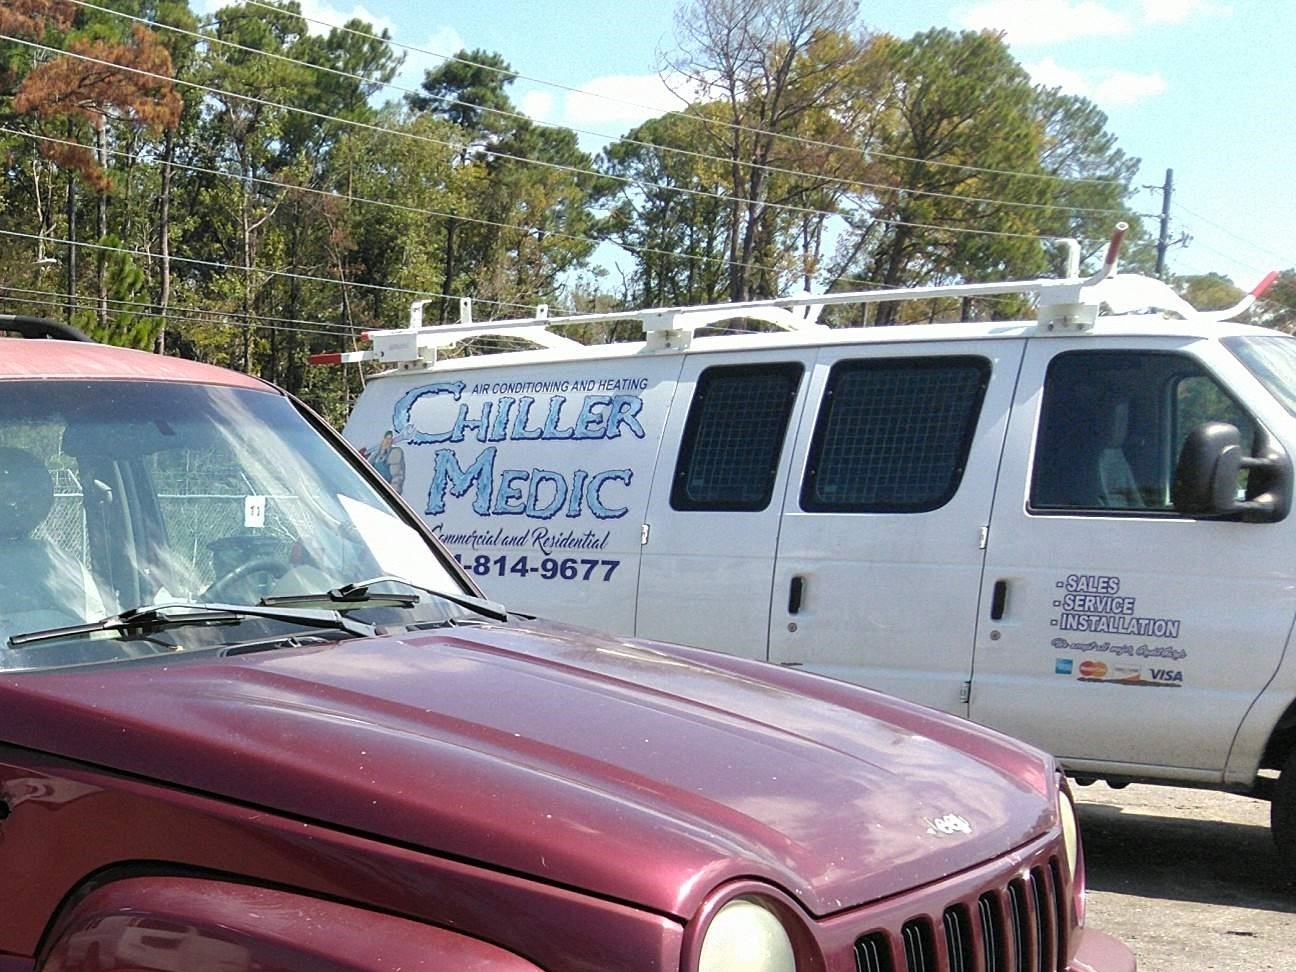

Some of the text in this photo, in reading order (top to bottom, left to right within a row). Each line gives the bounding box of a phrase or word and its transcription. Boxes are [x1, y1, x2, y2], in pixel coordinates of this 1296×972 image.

[472, 378, 649, 395] AIR CONDITIONING AND HEATING
[392, 380, 646, 445] CHILLER
[425, 446, 634, 520] MEDIC
[501, 528, 530, 548] and
[532, 527, 610, 555] Residential
[1149, 668, 1184, 682] VISA
